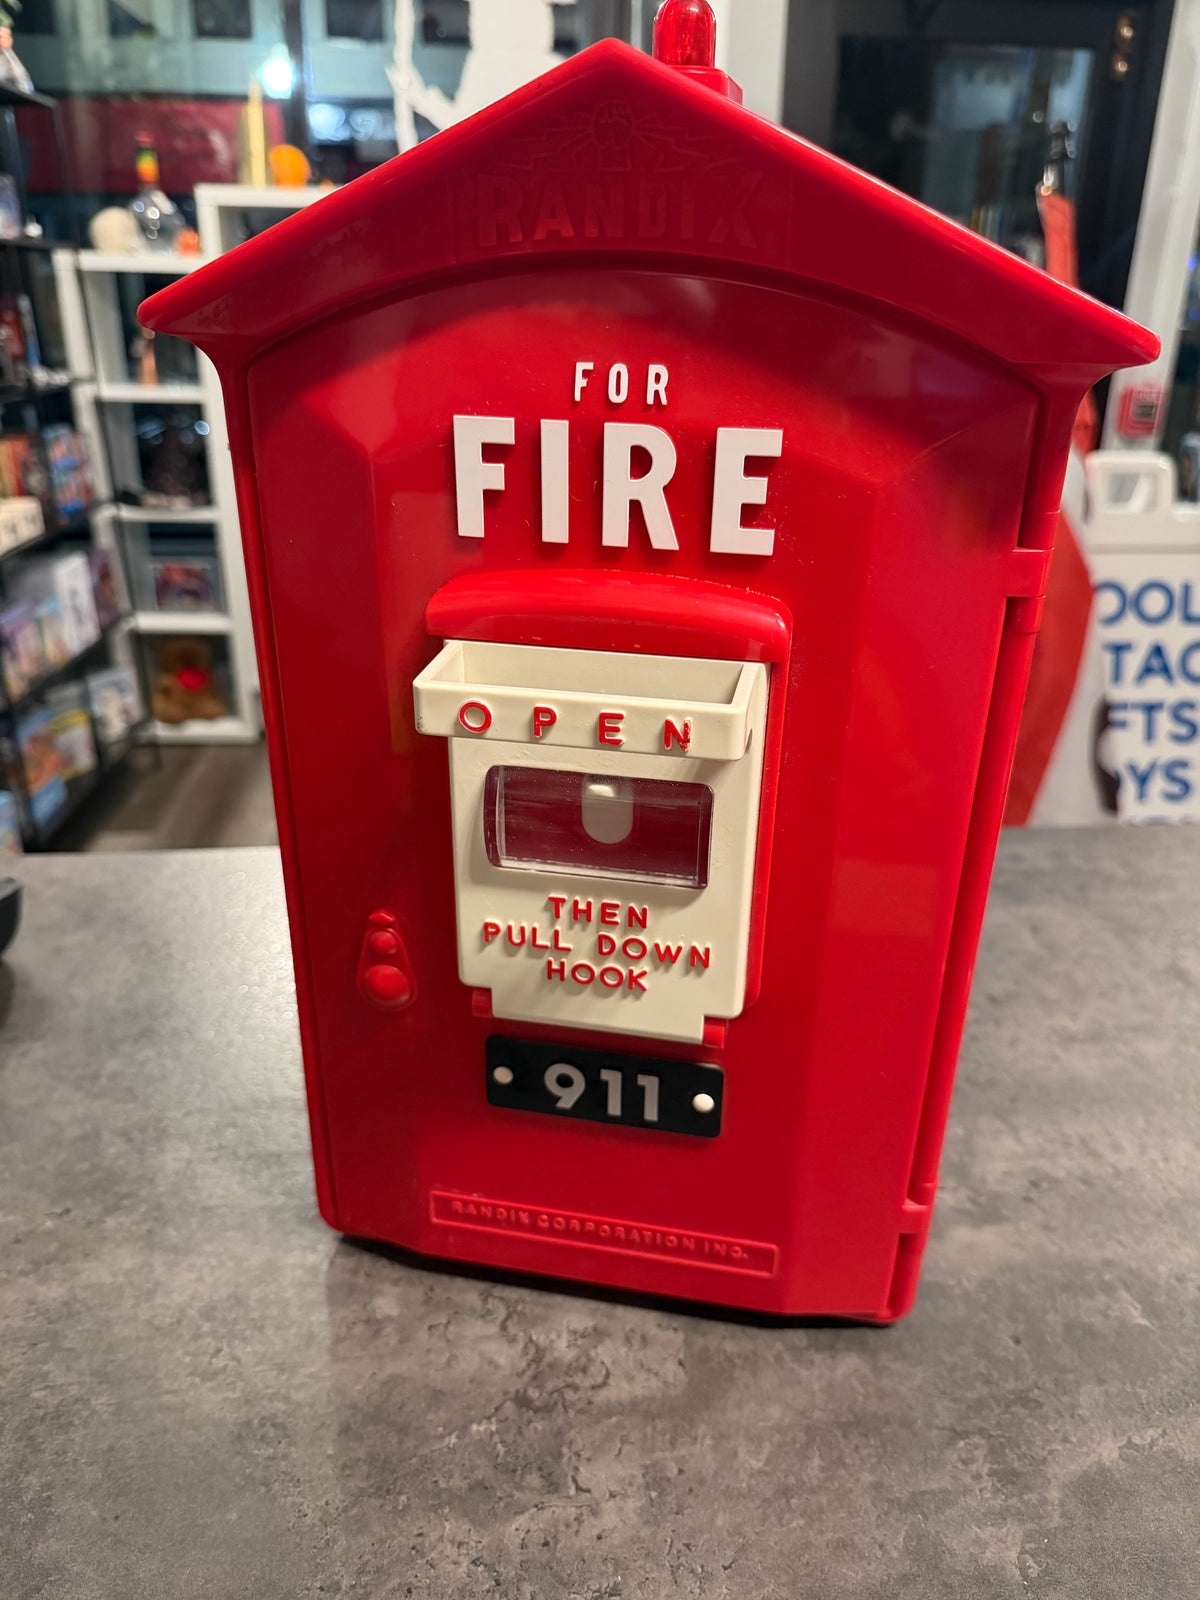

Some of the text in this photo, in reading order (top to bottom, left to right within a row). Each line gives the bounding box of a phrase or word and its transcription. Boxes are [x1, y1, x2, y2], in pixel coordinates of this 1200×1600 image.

[477, 172, 763, 249] RANDIX
[574, 361, 669, 406] FOR
[453, 414, 784, 556] FIRE
[458, 699, 693, 751] OPEN
[1114, 758, 1191, 804] YS
[547, 894, 649, 929] THEN
[483, 919, 712, 969] PULL DOWN
[546, 958, 649, 991] HOOK
[543, 1062, 660, 1122] 911
[451, 1200, 530, 1225] RANDIX
[536, 1213, 696, 1252] CORPORATION
